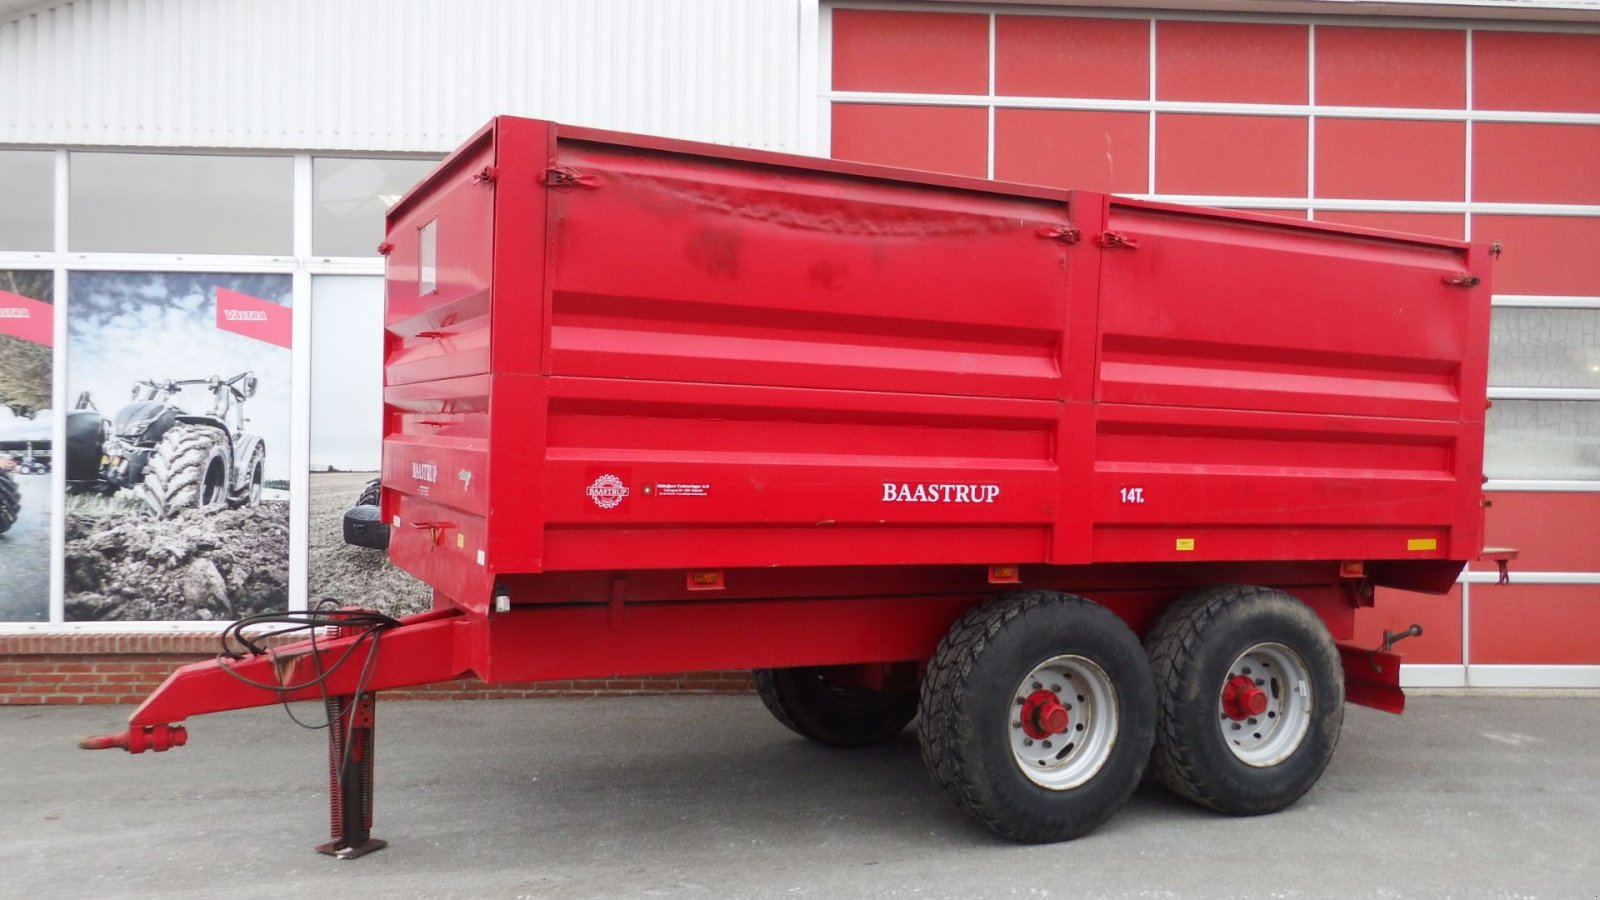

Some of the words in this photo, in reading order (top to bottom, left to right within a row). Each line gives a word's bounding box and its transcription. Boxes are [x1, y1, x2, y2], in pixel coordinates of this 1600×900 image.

[224, 309, 267, 321] VALTRA
[412, 462, 438, 484] BAASTRUP
[588, 488, 627, 496] BAASTRUP
[882, 482, 1000, 504] BAASTRUP
[1120, 487, 1145, 504] 14T.
